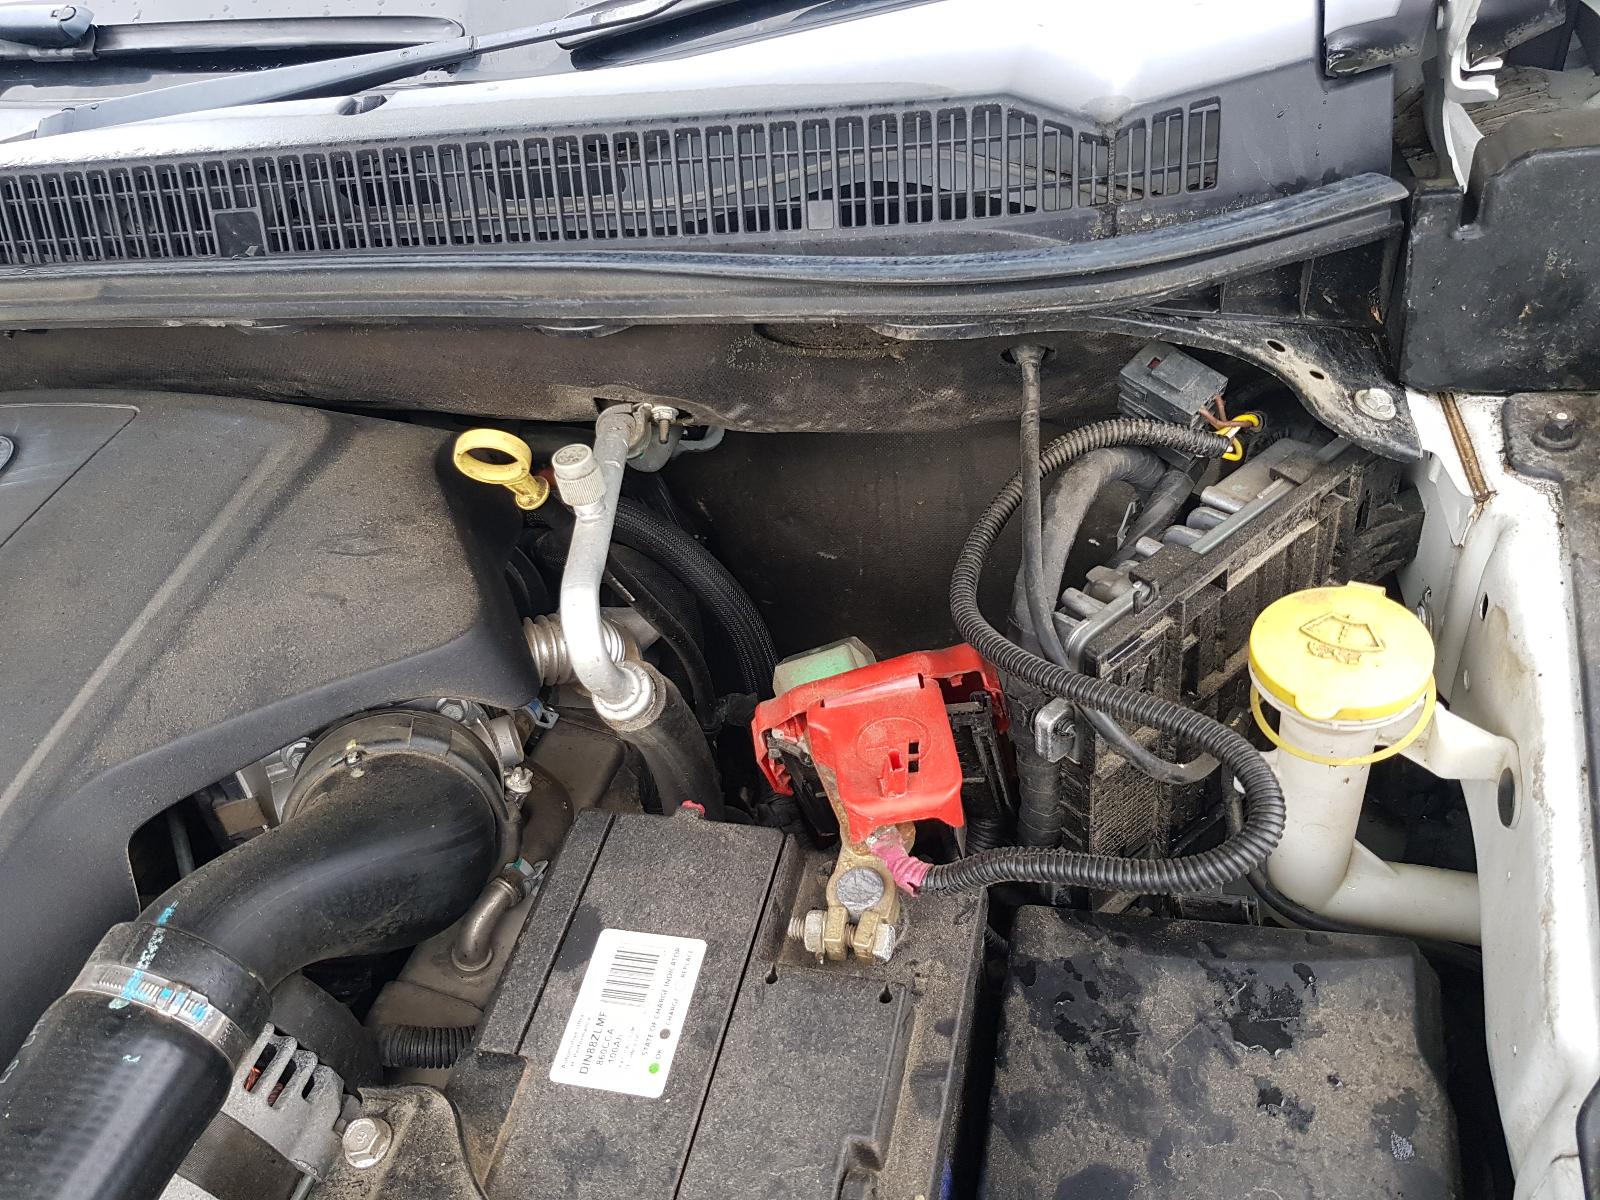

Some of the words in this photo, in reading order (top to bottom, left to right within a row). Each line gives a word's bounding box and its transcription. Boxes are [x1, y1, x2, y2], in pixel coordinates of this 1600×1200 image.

[641, 1034, 655, 1056] STATE
[649, 1021, 657, 1033] OF
[654, 989, 668, 1019] CHARGE
[664, 947, 681, 987] INDICATOR
[666, 998, 679, 1026] CHARGE
[579, 1011, 606, 1074] DIN88ZLMF
[596, 1029, 616, 1066] 860CCA
[655, 1049, 663, 1060] OK
